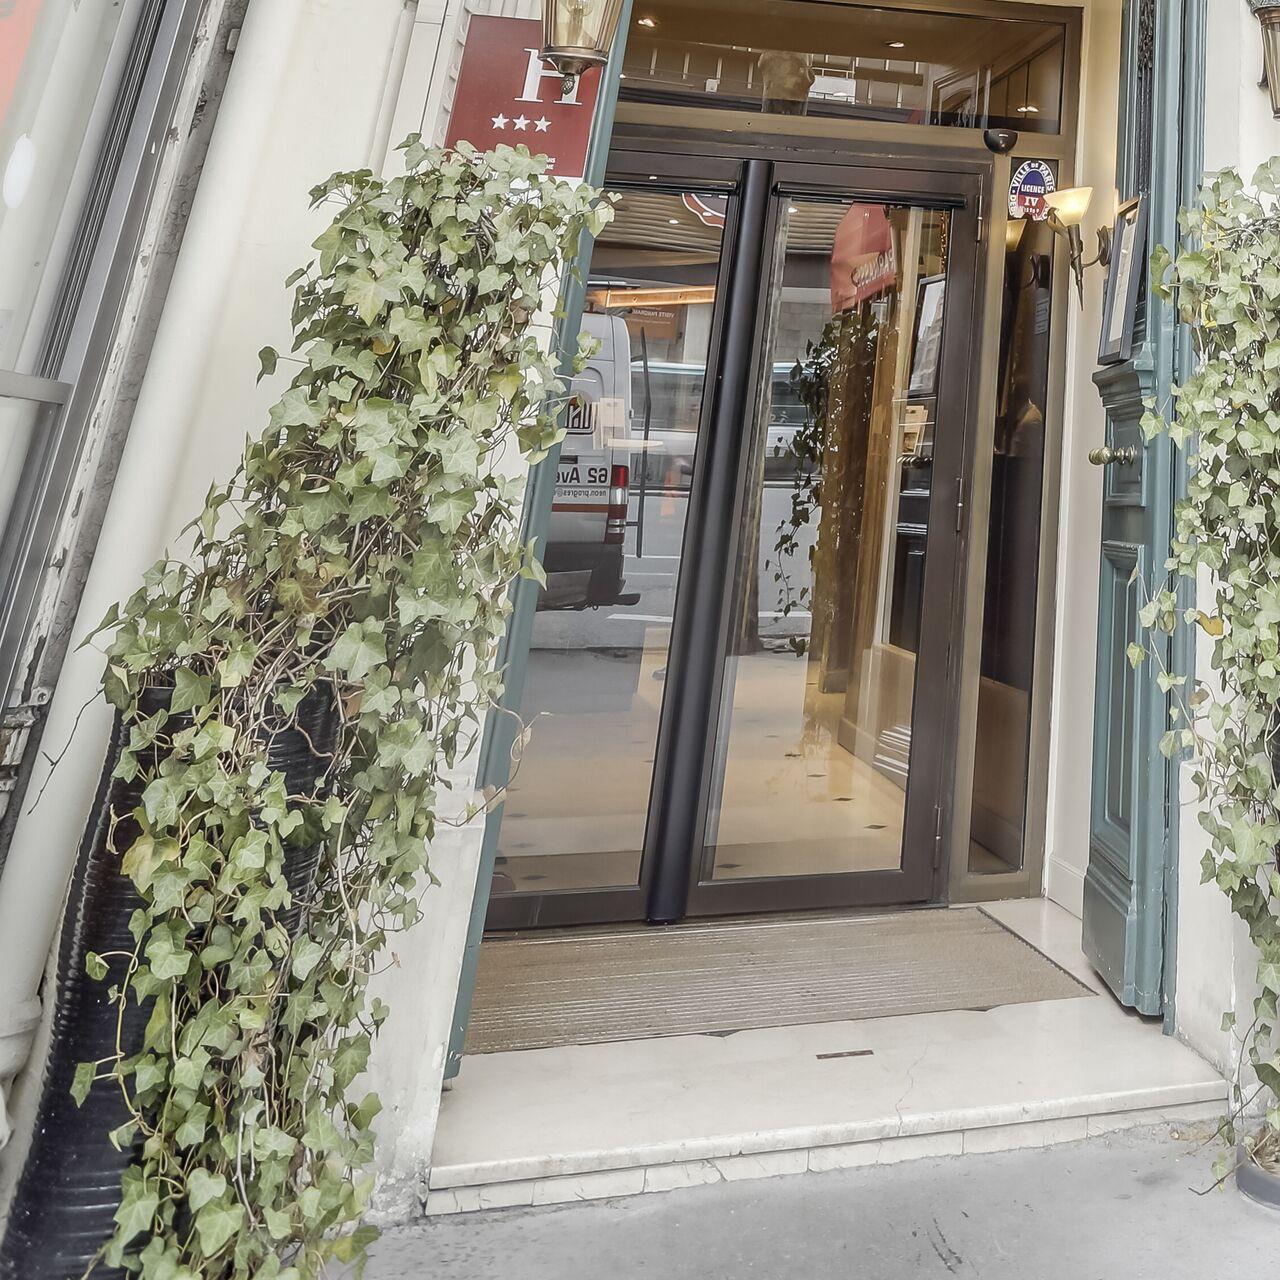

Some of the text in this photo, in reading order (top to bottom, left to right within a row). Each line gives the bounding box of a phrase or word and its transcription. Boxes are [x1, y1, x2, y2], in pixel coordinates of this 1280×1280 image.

[514, 48, 583, 106] H
[1012, 164, 1031, 187] VILLE
[1039, 164, 1054, 192] PARIS
[1021, 184, 1045, 194] LICENCE
[1024, 196, 1039, 207] IV
